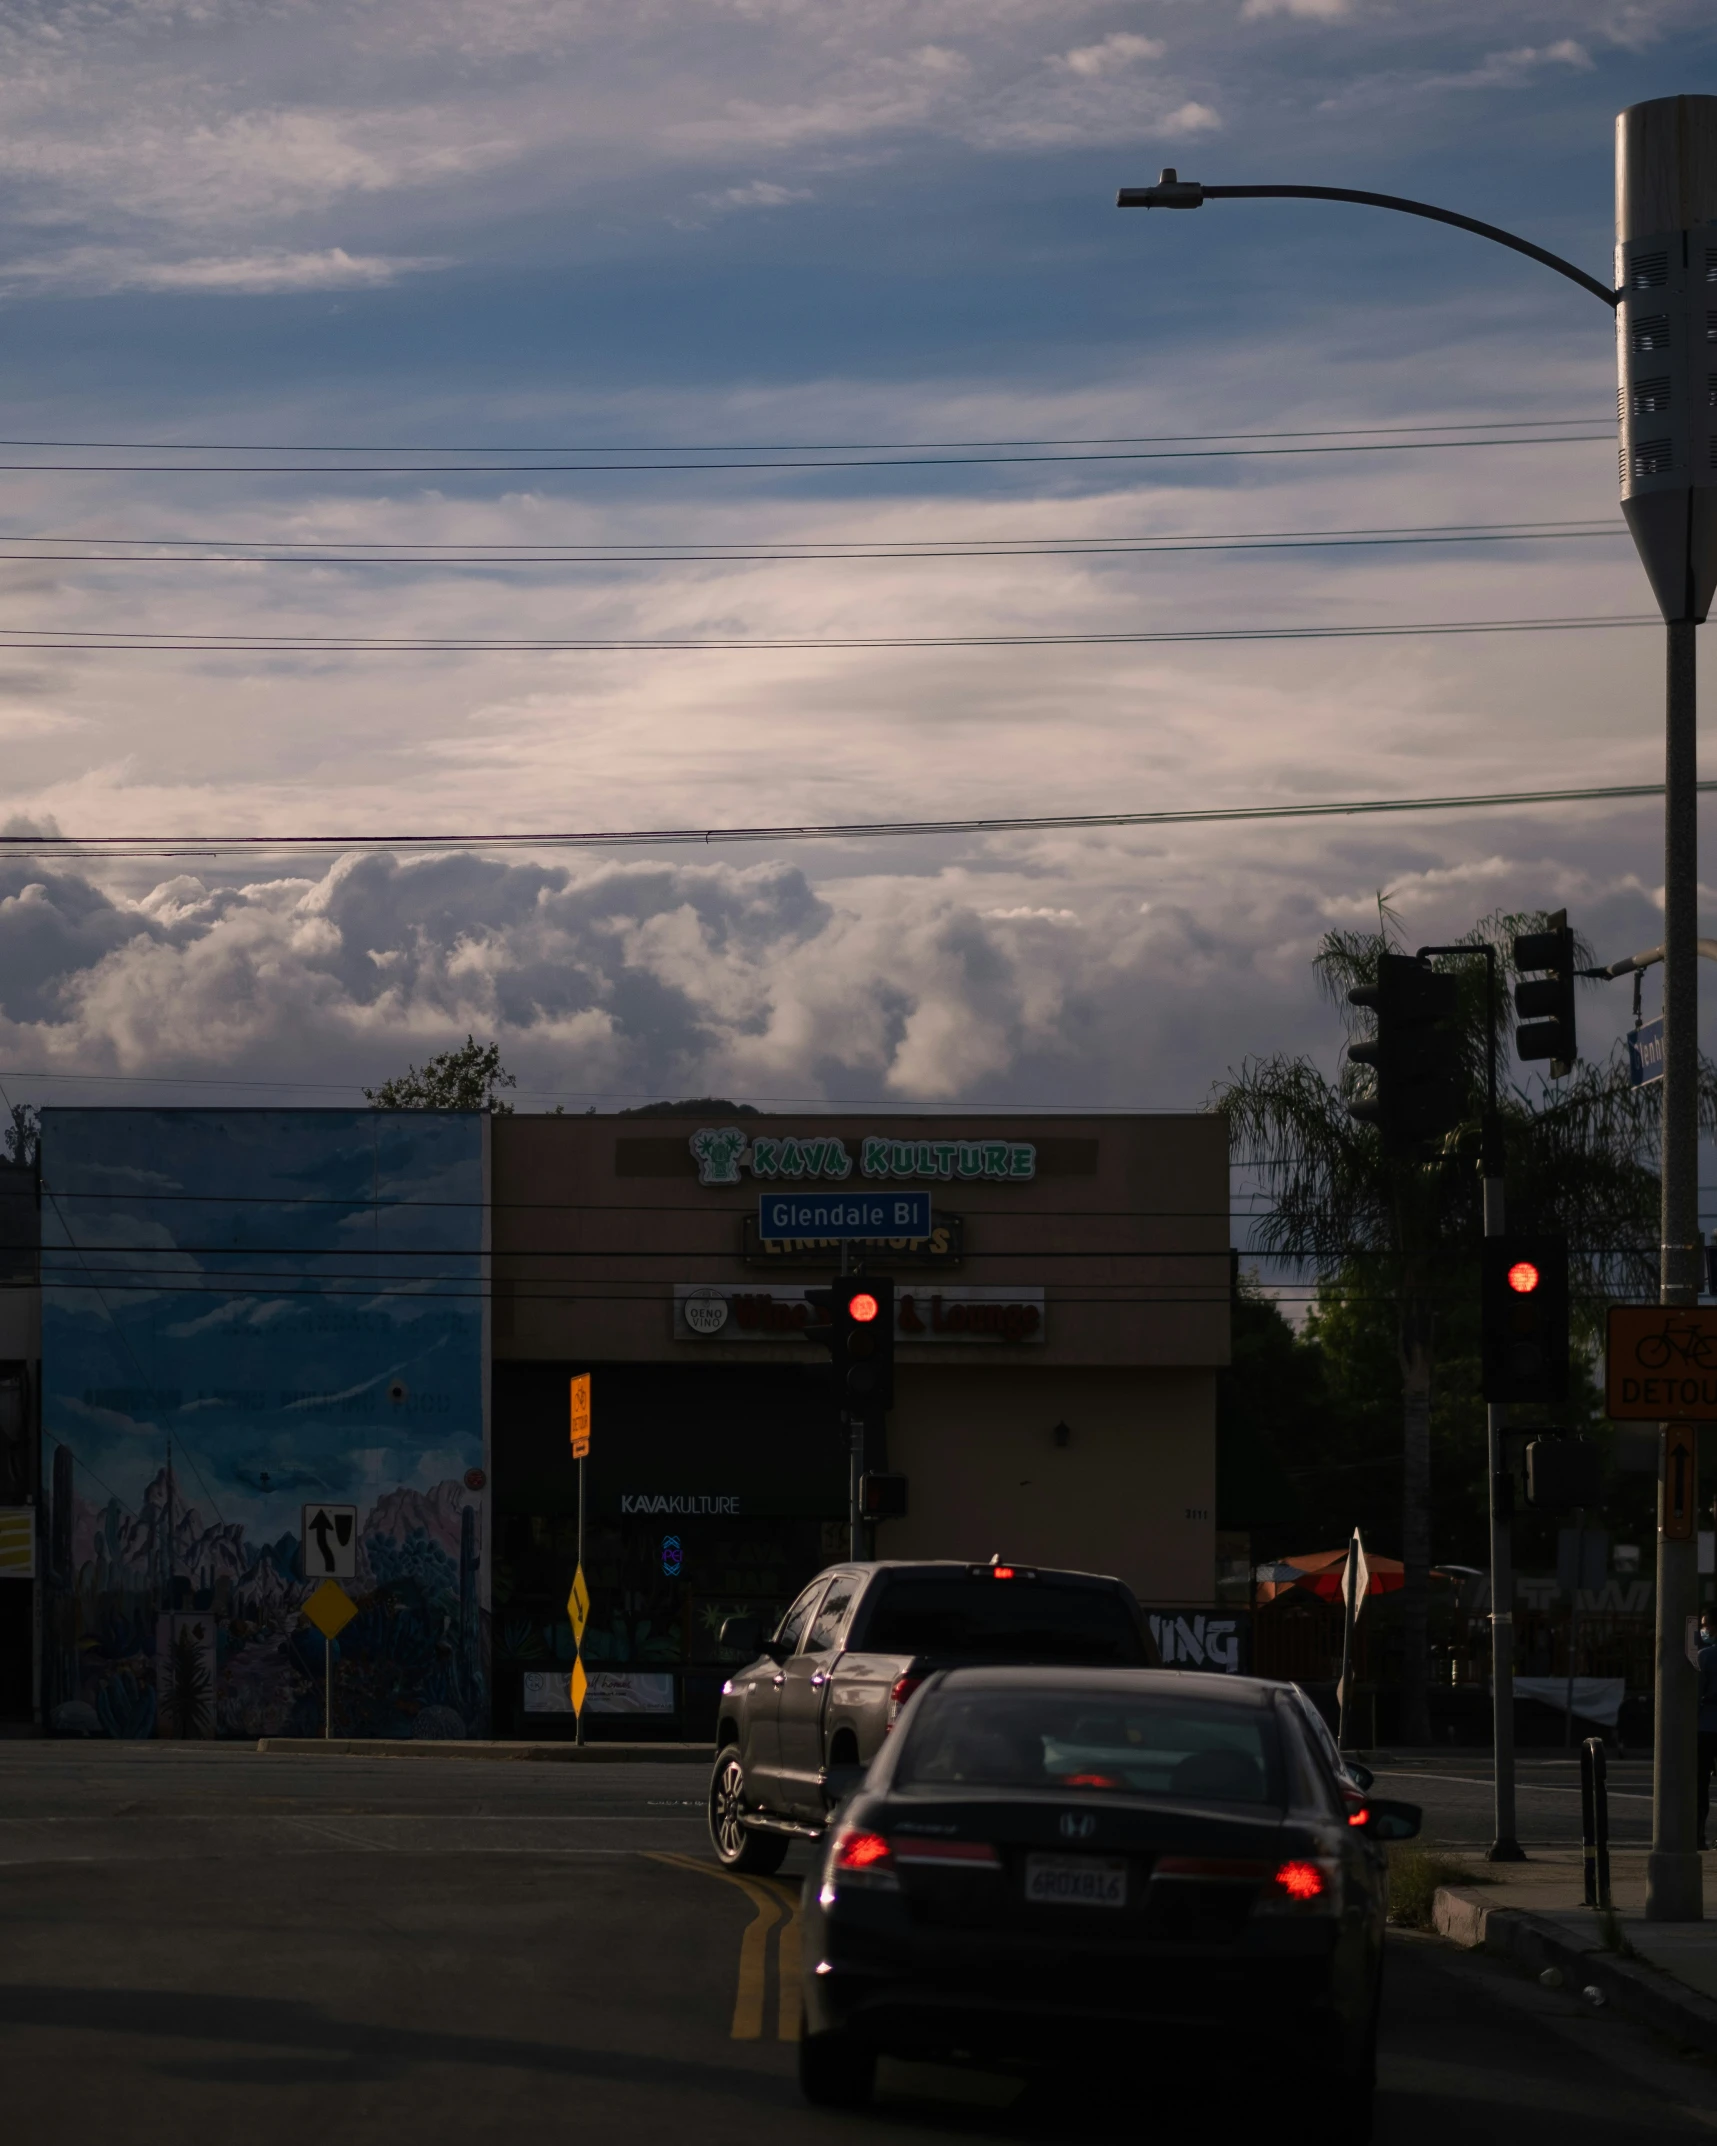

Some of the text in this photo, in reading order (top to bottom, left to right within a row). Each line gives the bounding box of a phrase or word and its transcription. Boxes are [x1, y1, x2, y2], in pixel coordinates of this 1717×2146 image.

[1634, 1035, 1665, 1071] Glenh
[756, 1141, 1035, 1179] KAVA KULTURE
[772, 1202, 919, 1227] Glendale Bl
[690, 1308, 723, 1319] OENO
[692, 1317, 721, 1328] VINO
[899, 1294, 927, 1331] &
[931, 1294, 1040, 1343] Lounge
[621, 1494, 740, 1514] KAVAKULTURE
